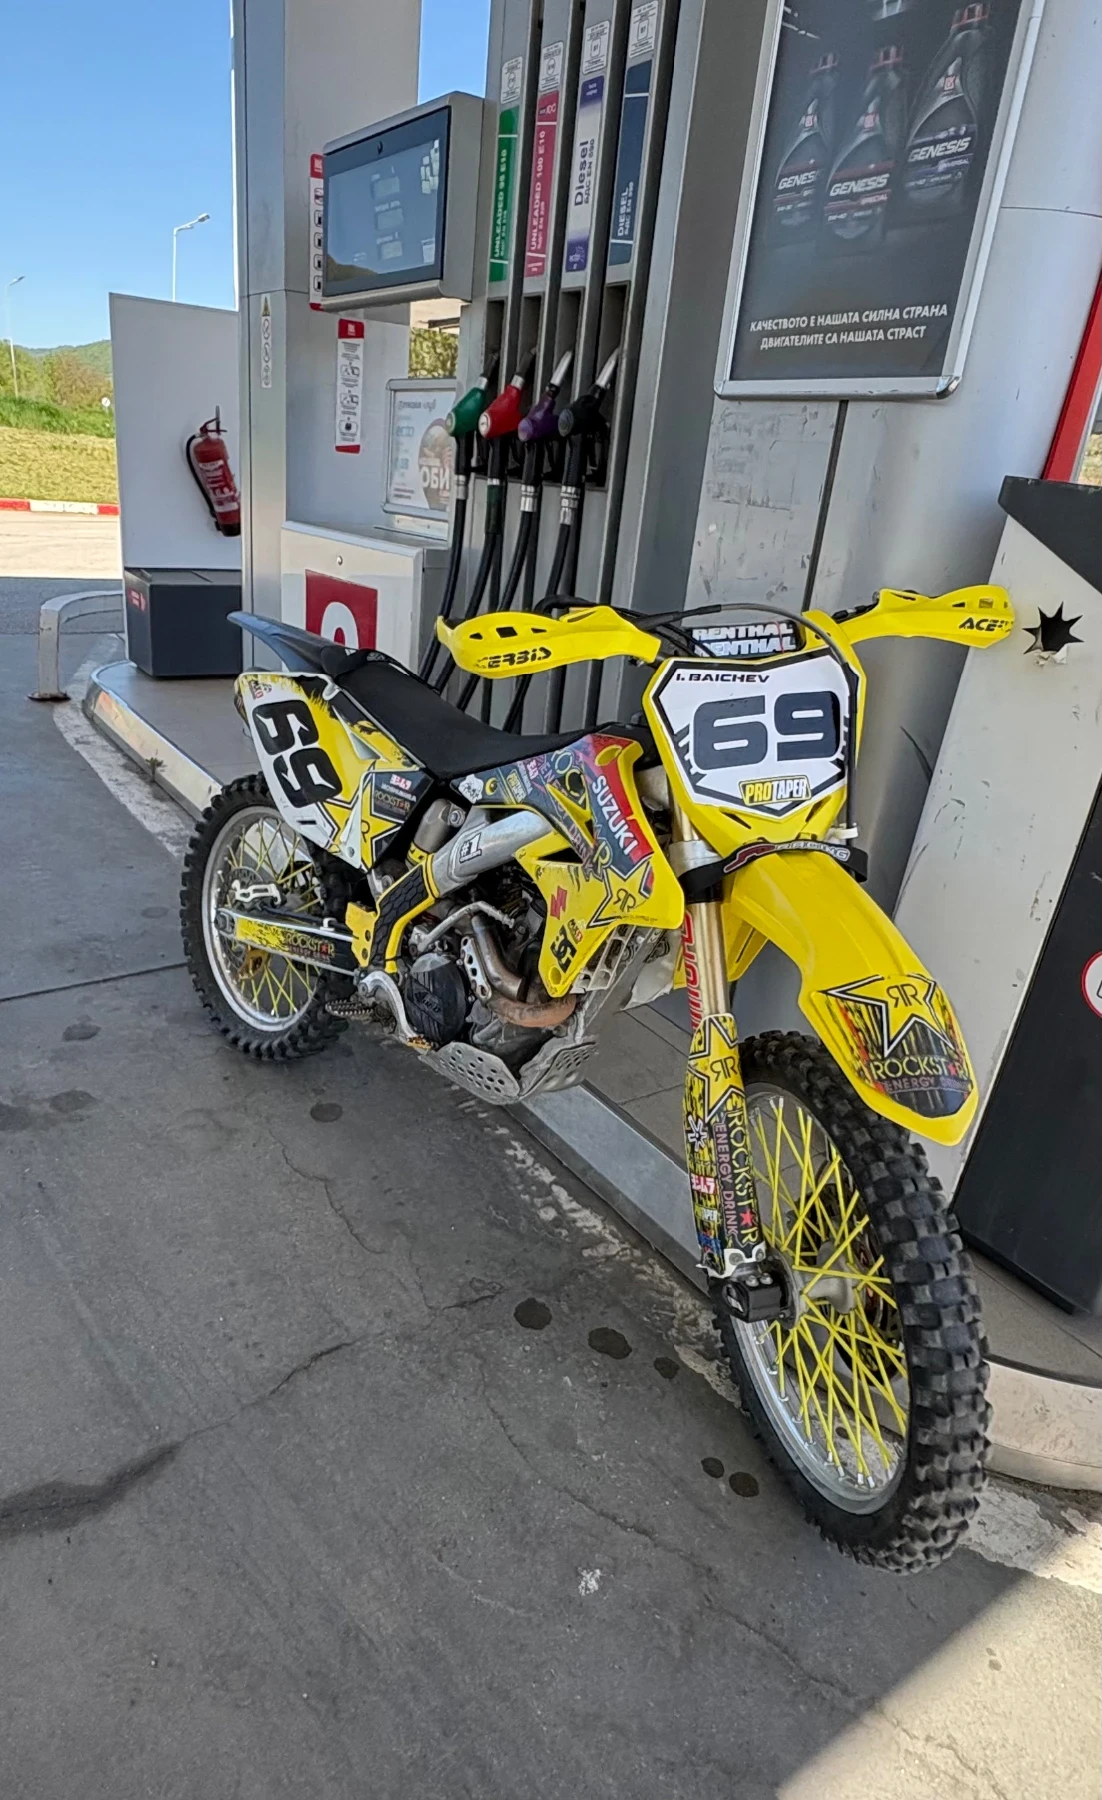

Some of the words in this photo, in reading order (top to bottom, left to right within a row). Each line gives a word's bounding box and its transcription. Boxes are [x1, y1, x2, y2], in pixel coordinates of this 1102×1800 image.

[907, 137, 971, 163] GENESIS
[531, 182, 541, 250] UNLEADED
[538, 131, 546, 154] E10
[574, 140, 588, 206] Diesel
[778, 171, 817, 190] GENES
[829, 173, 890, 197] GENESIS
[494, 191, 504, 257] UNLEADED
[618, 187, 628, 237] DIESEL
[750, 316, 808, 332] КАЧЕСТВОТО
[817, 312, 860, 327] НАШАТА
[862, 308, 900, 323] СИЛНА
[902, 304, 947, 319] СТРАНА
[760, 333, 824, 350] ДВИГАТЕЛИТЕ
[825, 333, 838, 344] СА
[840, 328, 884, 343] НАШАТА
[887, 325, 927, 340] СТРАСТ
[692, 623, 793, 641] RENTHAL
[689, 673, 770, 683] BAICHEV
[694, 691, 840, 770] 69
[252, 700, 343, 808] 69
[746, 779, 807, 802] PROTAPER
[592, 775, 638, 856] SUZUKI
[883, 1076, 935, 1092] ENERGY
[715, 1123, 732, 1184] ENERGY
[722, 1190, 738, 1236] DRINK
